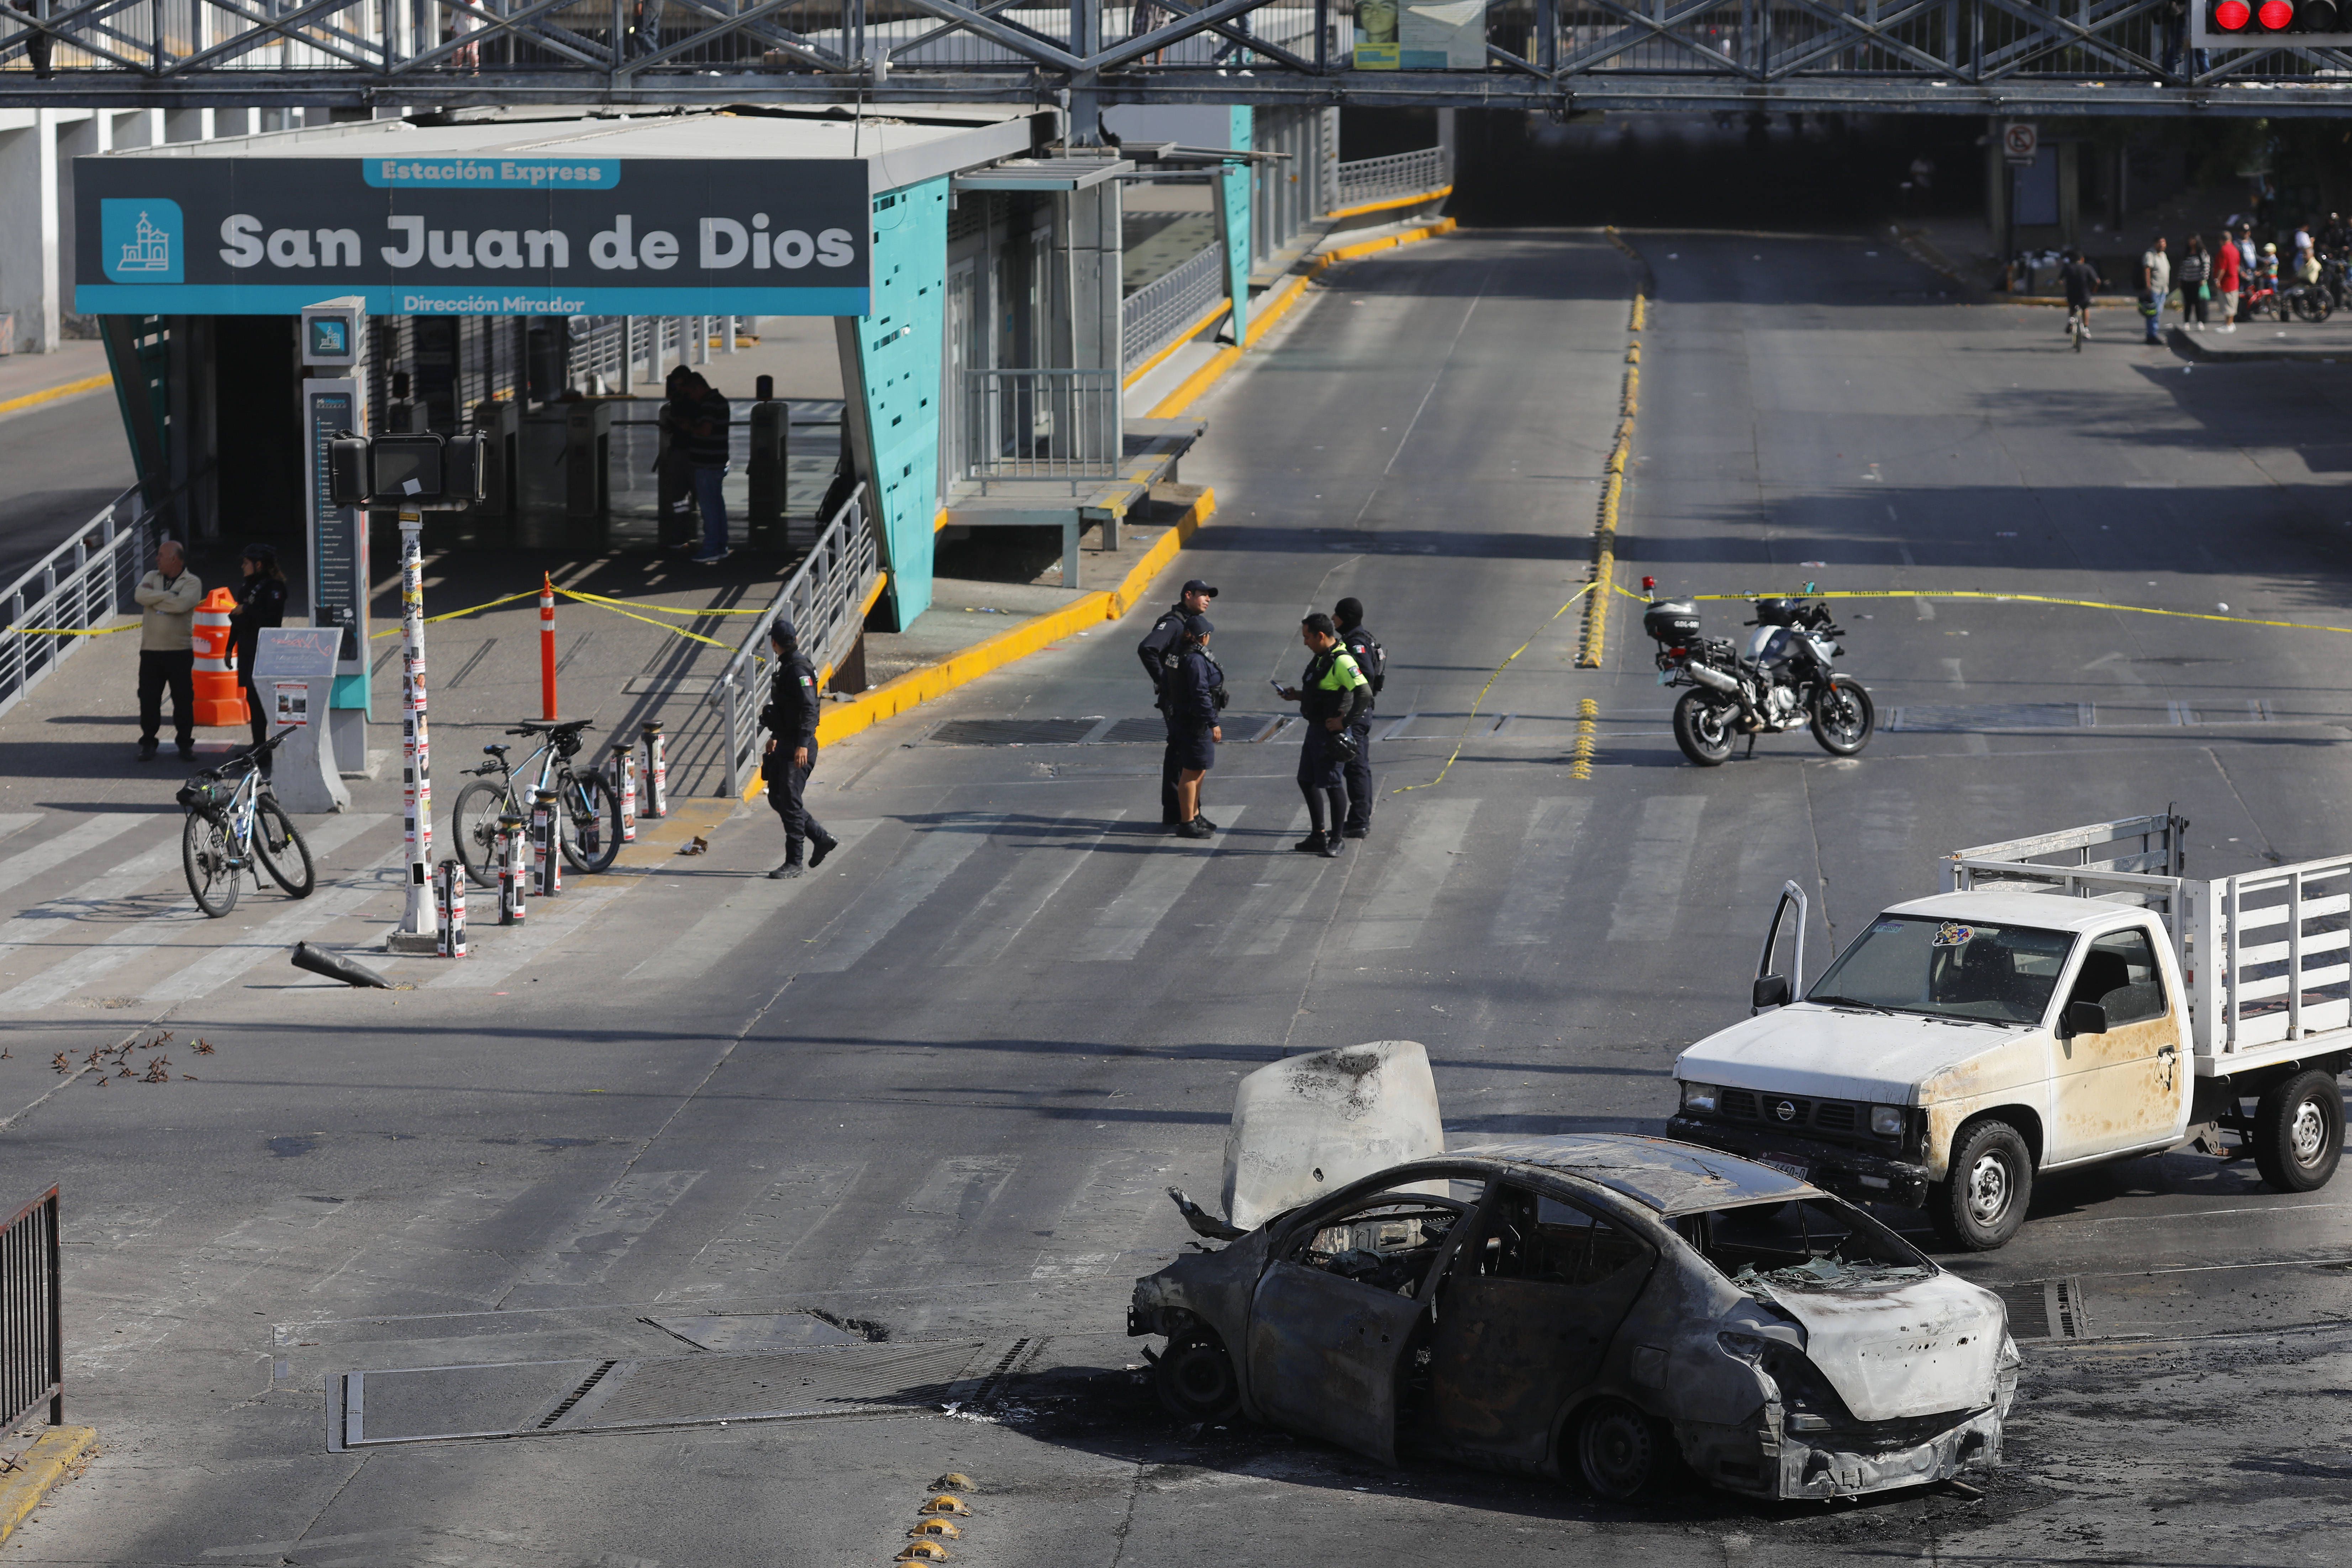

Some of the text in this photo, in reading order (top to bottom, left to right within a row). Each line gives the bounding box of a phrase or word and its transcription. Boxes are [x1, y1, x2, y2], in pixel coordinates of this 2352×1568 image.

[382, 160, 601, 185] Estación Express
[219, 212, 854, 270] San Juan de Dios
[404, 295, 585, 313] Dirección Mirador
